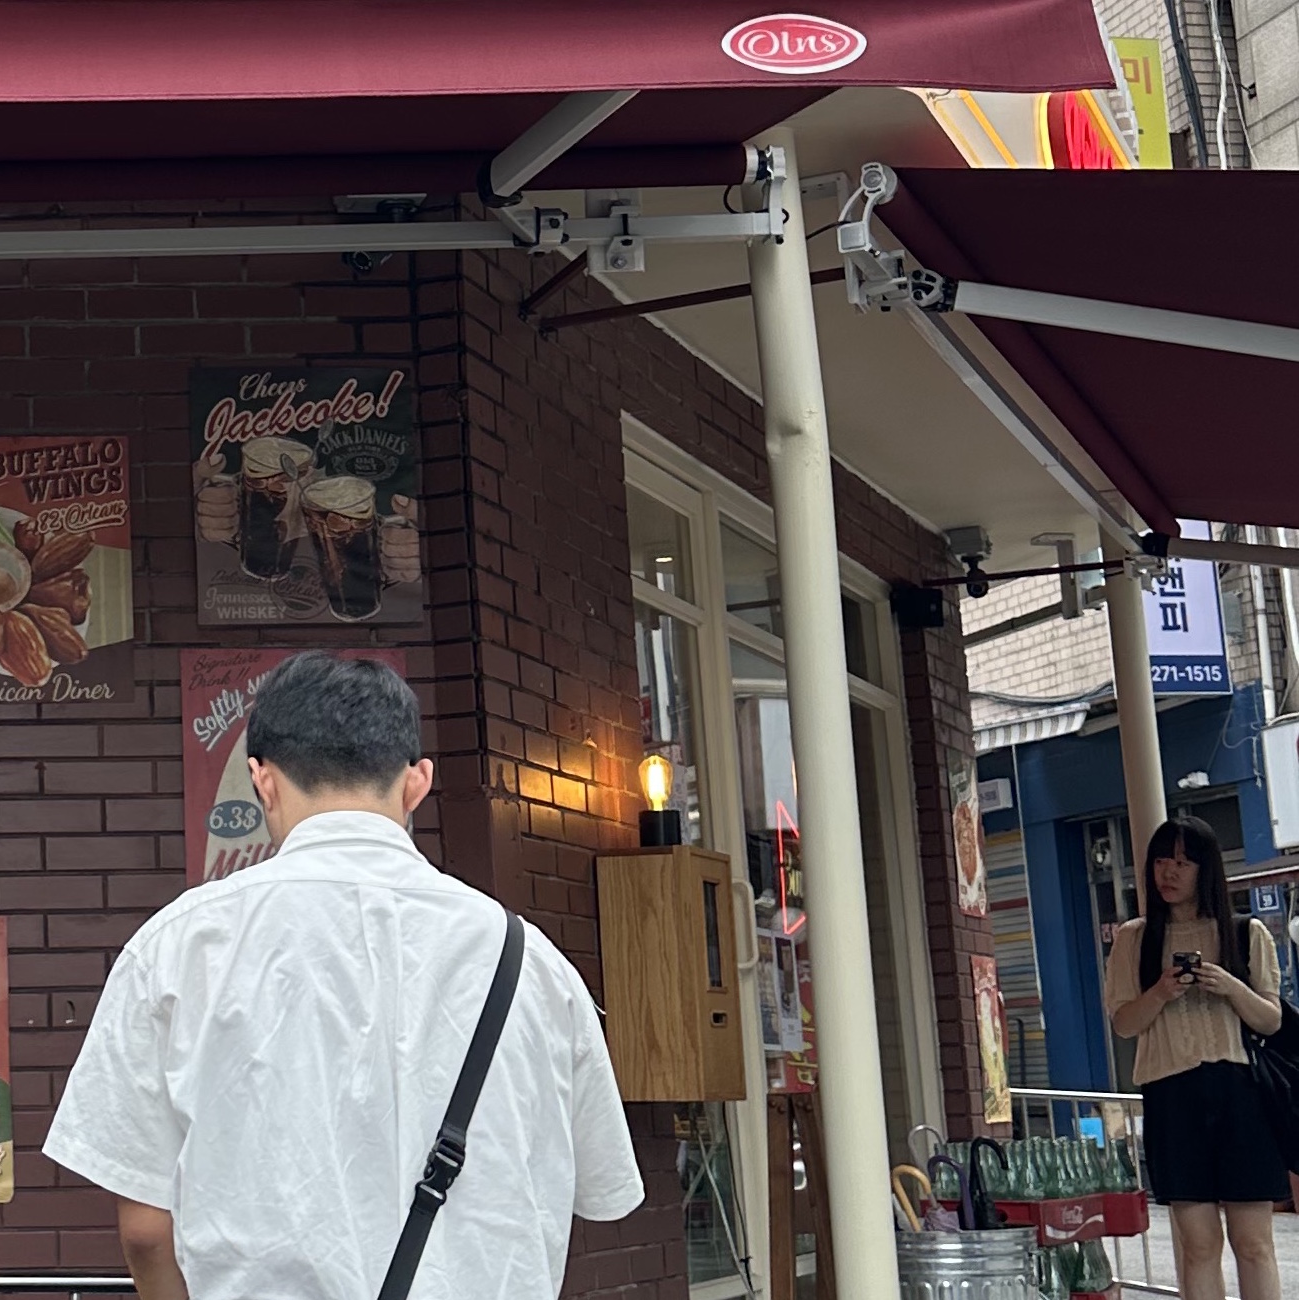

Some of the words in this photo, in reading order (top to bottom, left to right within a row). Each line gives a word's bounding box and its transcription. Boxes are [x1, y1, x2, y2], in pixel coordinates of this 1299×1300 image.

[239, 371, 308, 402] Cheers
[22, 464, 125, 505] WINGS
[216, 606, 287, 620] WHISKEY
[52, 672, 115, 701] Diner
[192, 688, 244, 743] Softly
[209, 806, 257, 831] 6.3$
